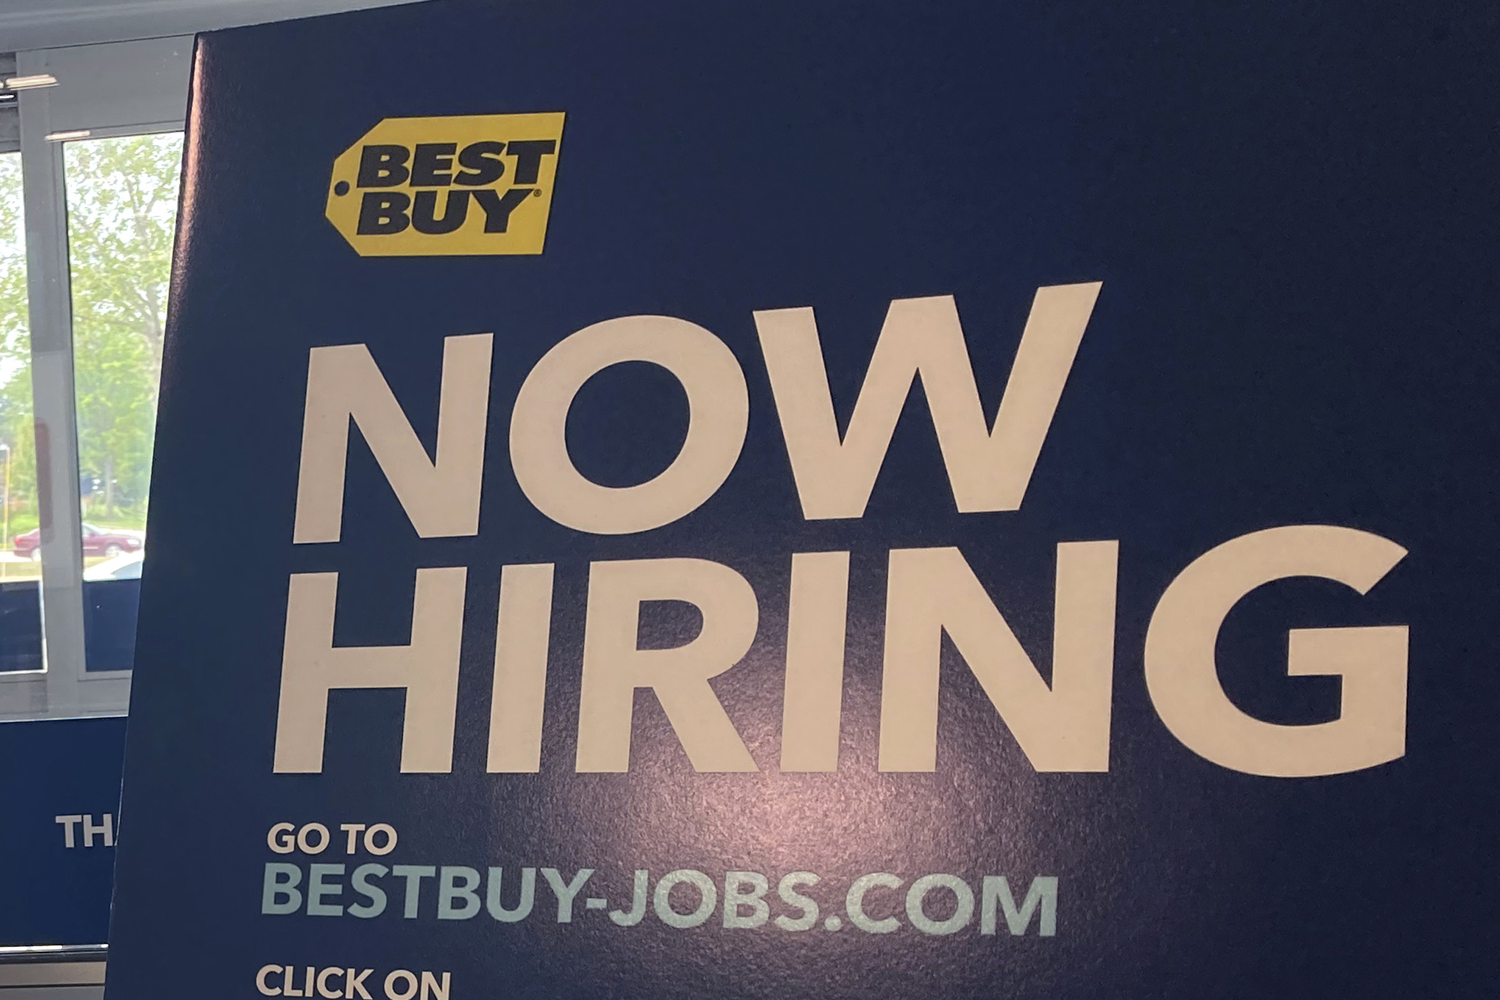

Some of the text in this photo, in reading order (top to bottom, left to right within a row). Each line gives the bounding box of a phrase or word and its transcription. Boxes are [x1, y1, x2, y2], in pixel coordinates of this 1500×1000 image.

[357, 140, 557, 188] BEST
[357, 188, 534, 236] BUY
[293, 281, 1104, 545] NOW
[273, 524, 1410, 778] HIRING
[55, 813, 117, 848] TH
[267, 822, 398, 856] GO TO
[261, 862, 1059, 937] BESTBUY-JOBS.COM
[255, 964, 374, 1000] CLICK
